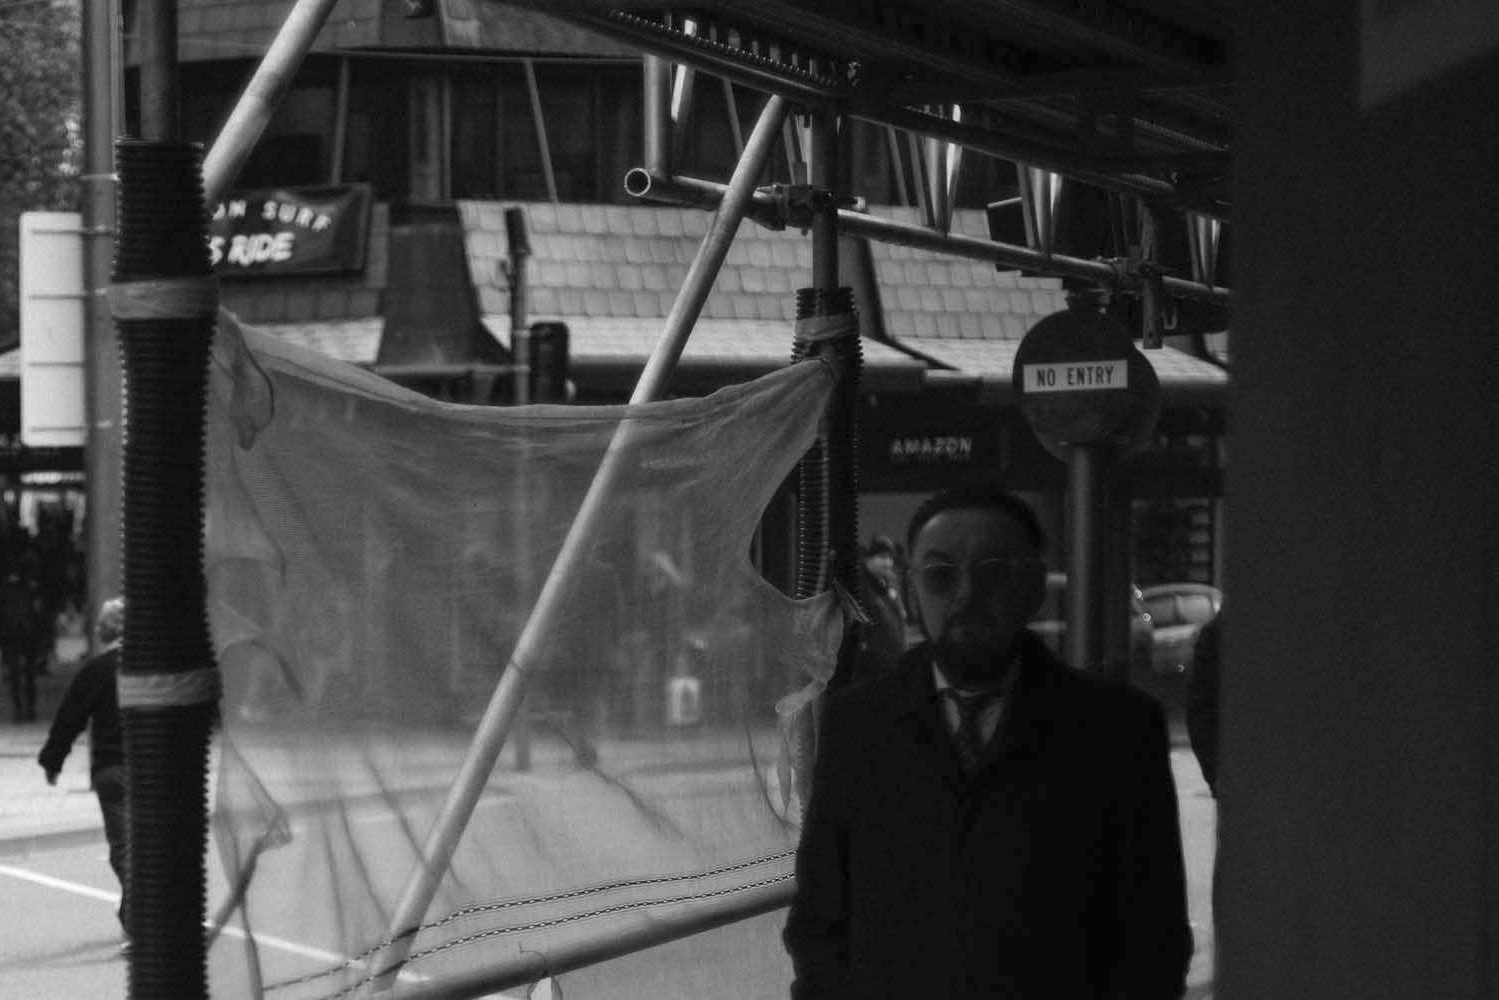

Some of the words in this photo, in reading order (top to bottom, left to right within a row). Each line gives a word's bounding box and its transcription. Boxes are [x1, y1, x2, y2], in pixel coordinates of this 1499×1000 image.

[262, 201, 332, 231] SURF
[228, 232, 295, 266] RIDE
[1037, 368, 1056, 387] NO
[1067, 366, 1114, 385] ENTRY
[889, 436, 973, 456] AMAZON
